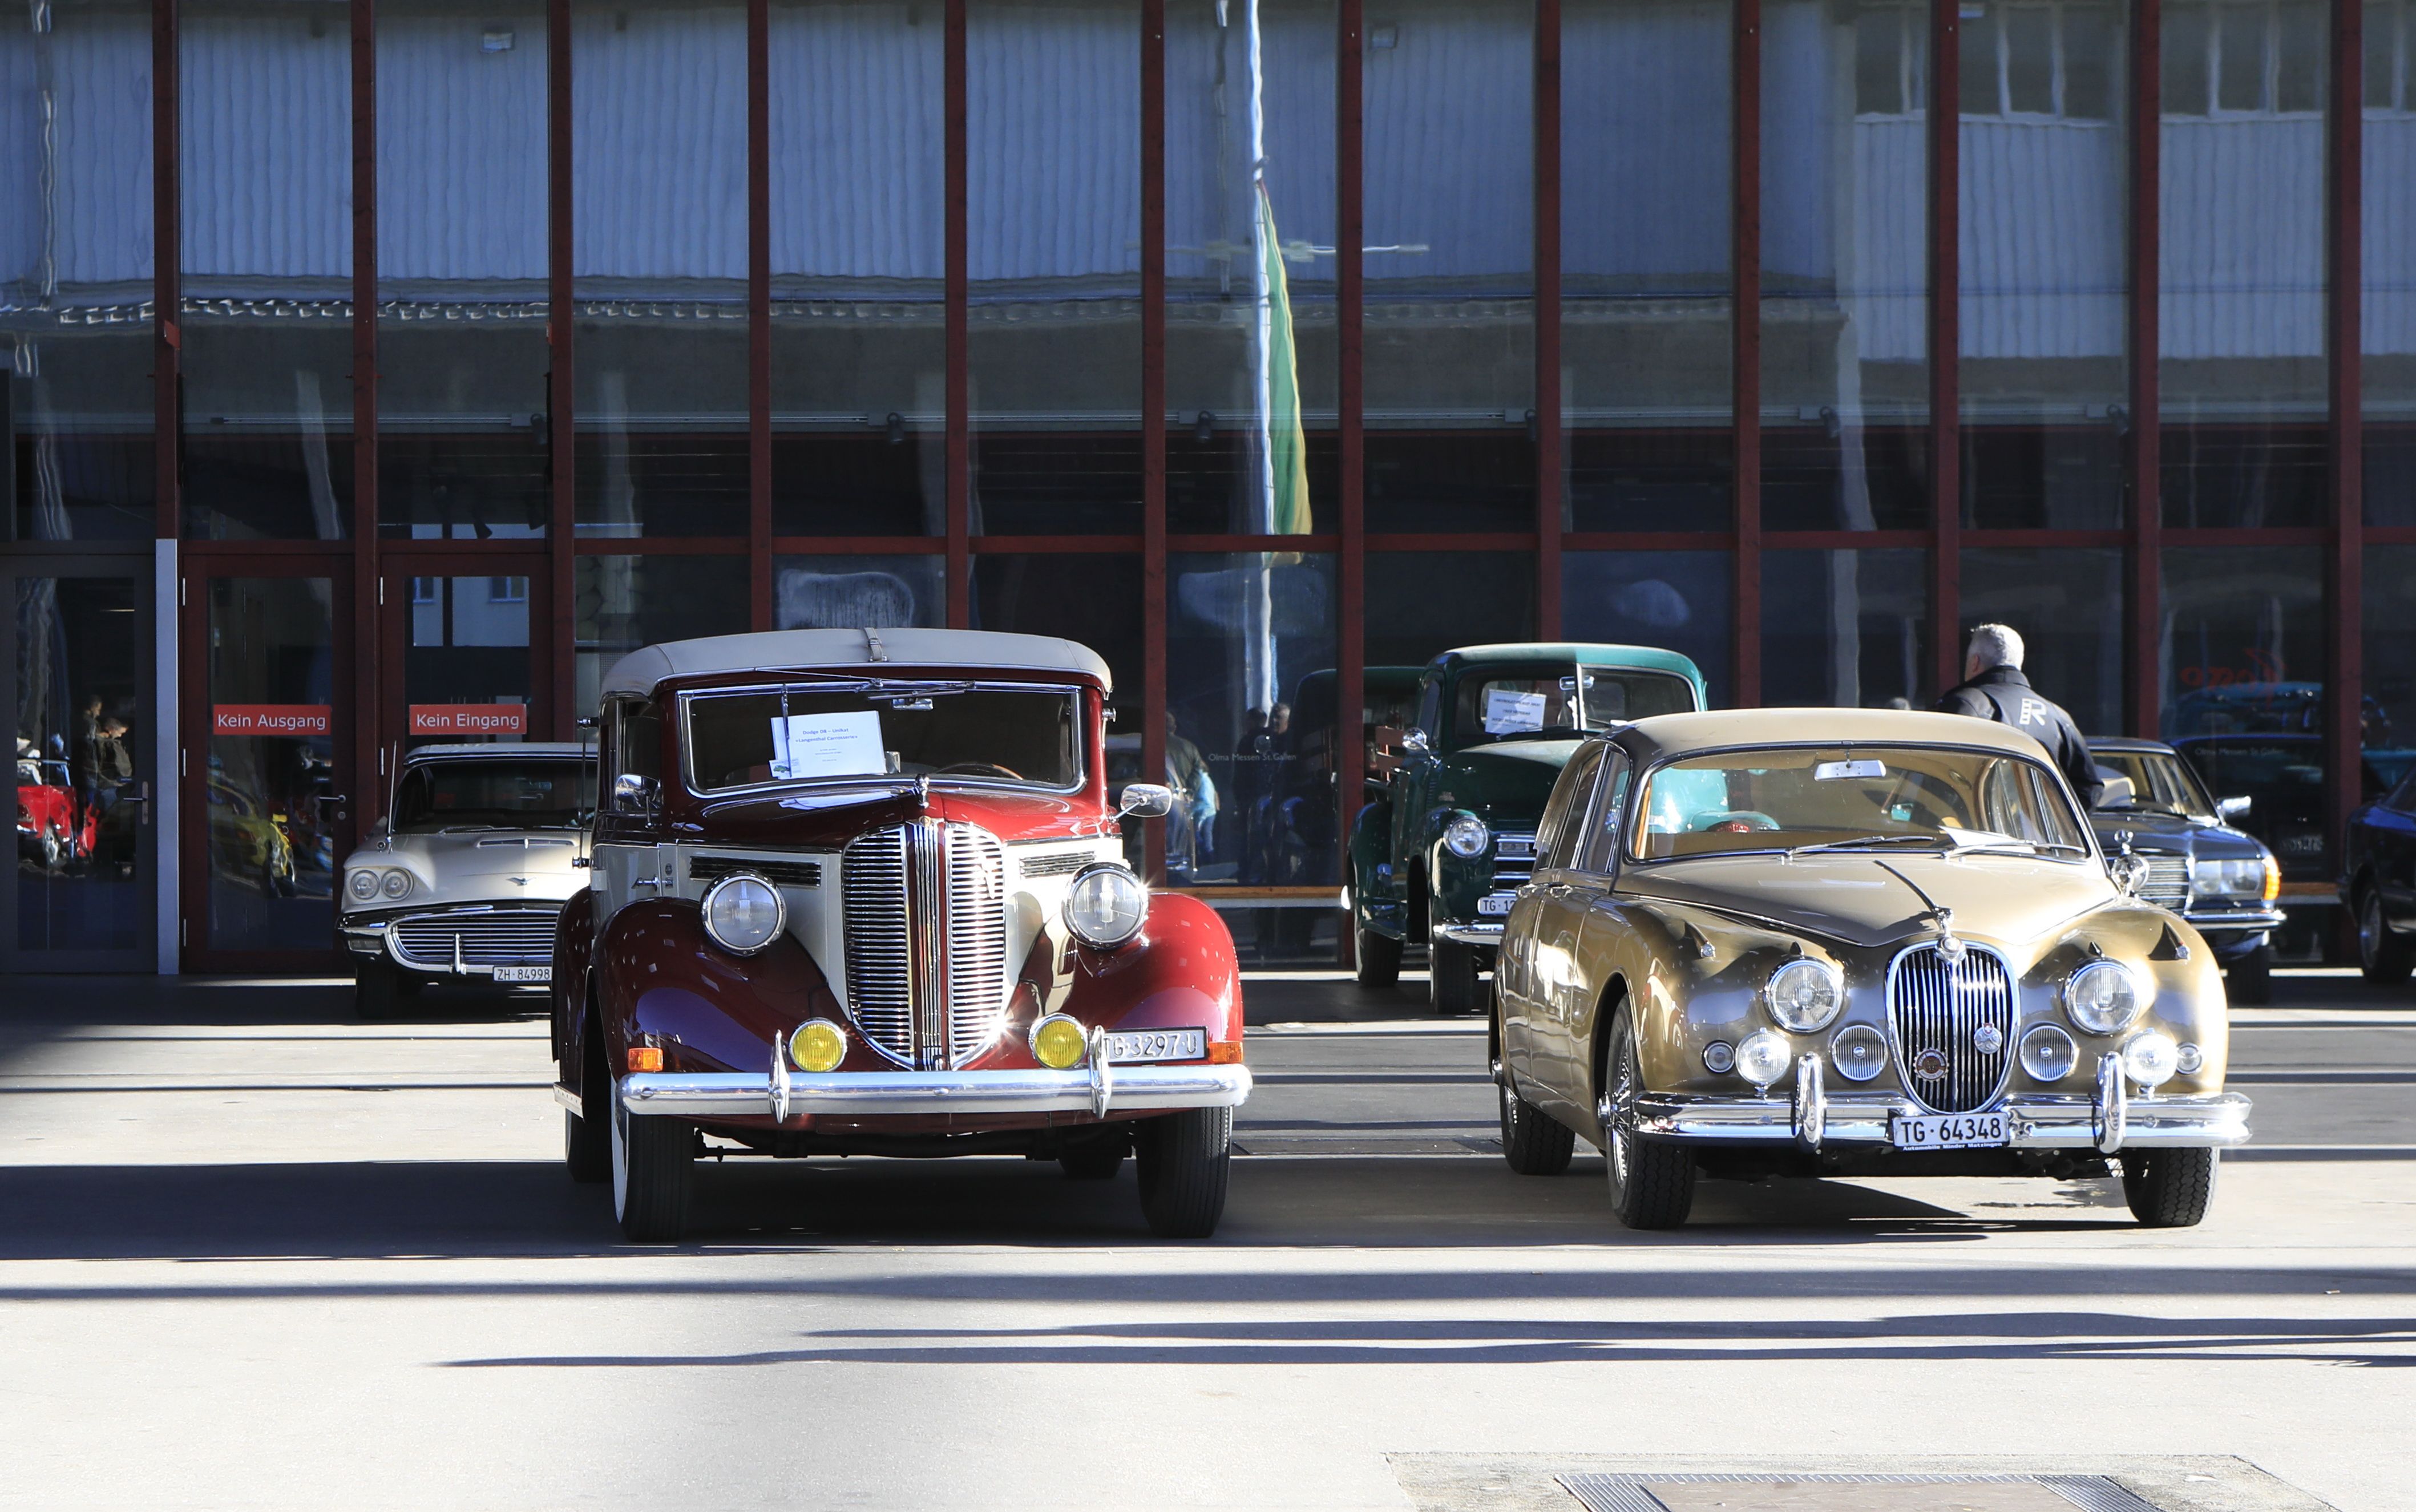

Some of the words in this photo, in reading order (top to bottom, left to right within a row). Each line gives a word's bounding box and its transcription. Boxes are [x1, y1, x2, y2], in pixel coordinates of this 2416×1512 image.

[217, 713, 251, 727] Kein
[257, 713, 326, 731] Ausgang
[416, 713, 450, 727] Kein
[457, 713, 520, 730] Eingang
